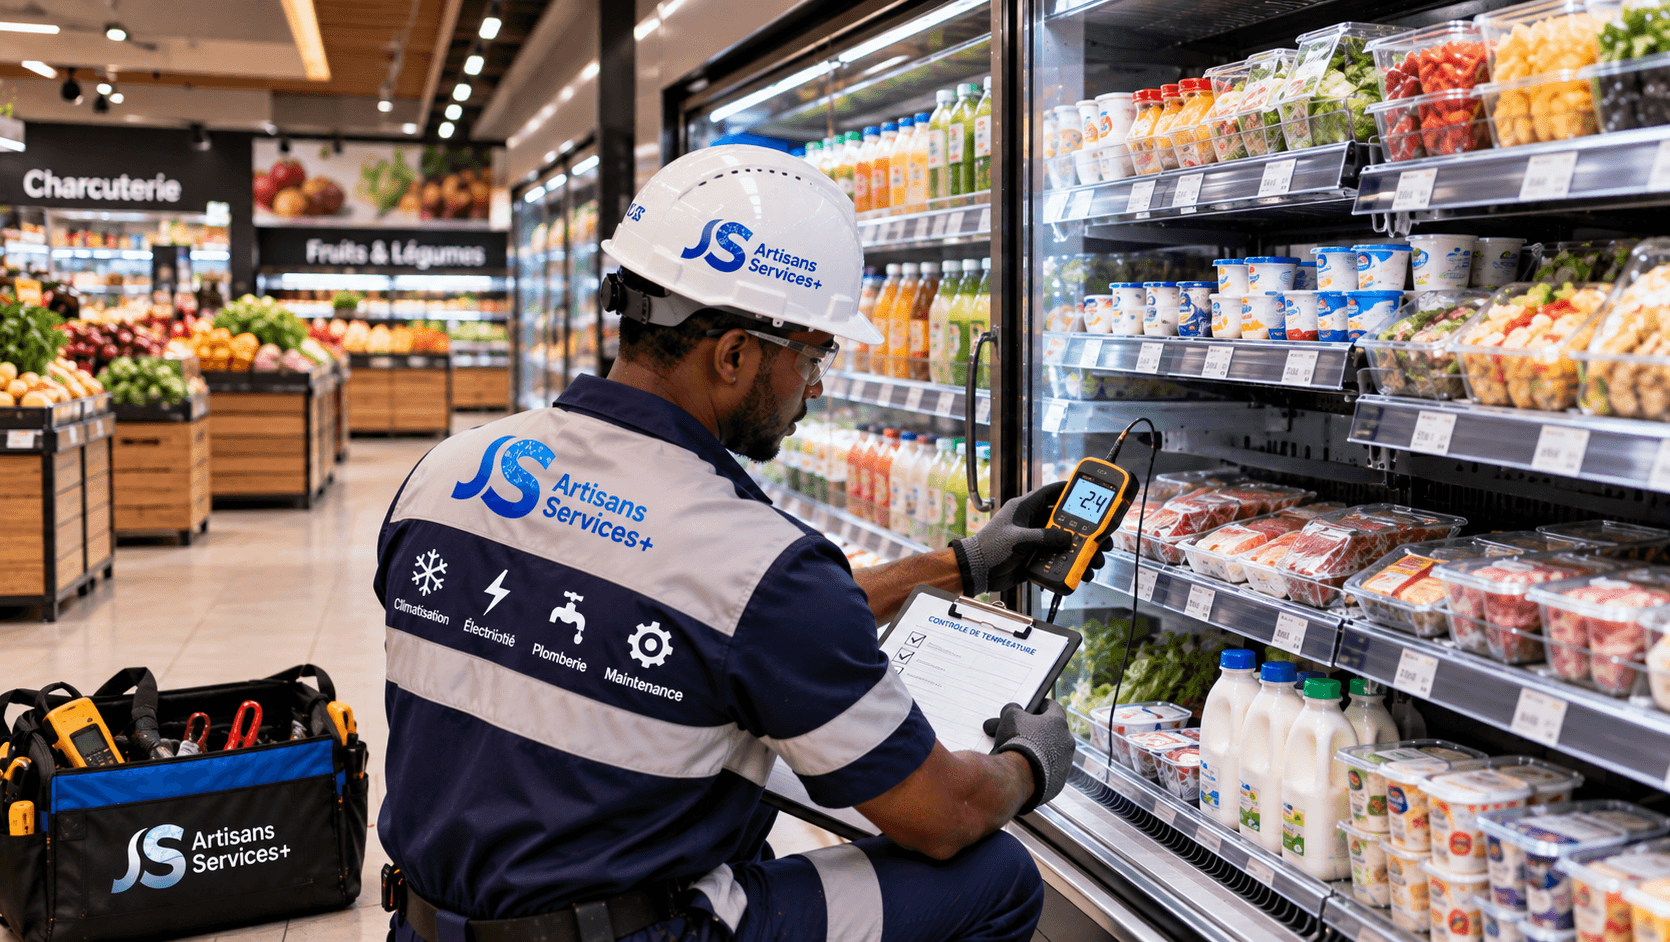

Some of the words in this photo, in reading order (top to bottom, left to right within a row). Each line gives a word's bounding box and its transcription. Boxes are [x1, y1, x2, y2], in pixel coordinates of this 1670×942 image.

[23, 168, 182, 202] Charcuterie
[306, 238, 368, 265] Fruits
[370, 239, 389, 265] &
[391, 238, 486, 270] Légumes
[753, 243, 818, 272] Artisans
[748, 258, 822, 290] Services+
[552, 473, 648, 522] Artisans
[542, 496, 654, 552] Services+
[393, 597, 450, 625] Climatisation
[969, 628, 981, 638] DE
[532, 643, 587, 672] Plomberie
[604, 667, 684, 702] Maintenance
[191, 824, 275, 851] Artisans
[192, 844, 291, 874] Services+
